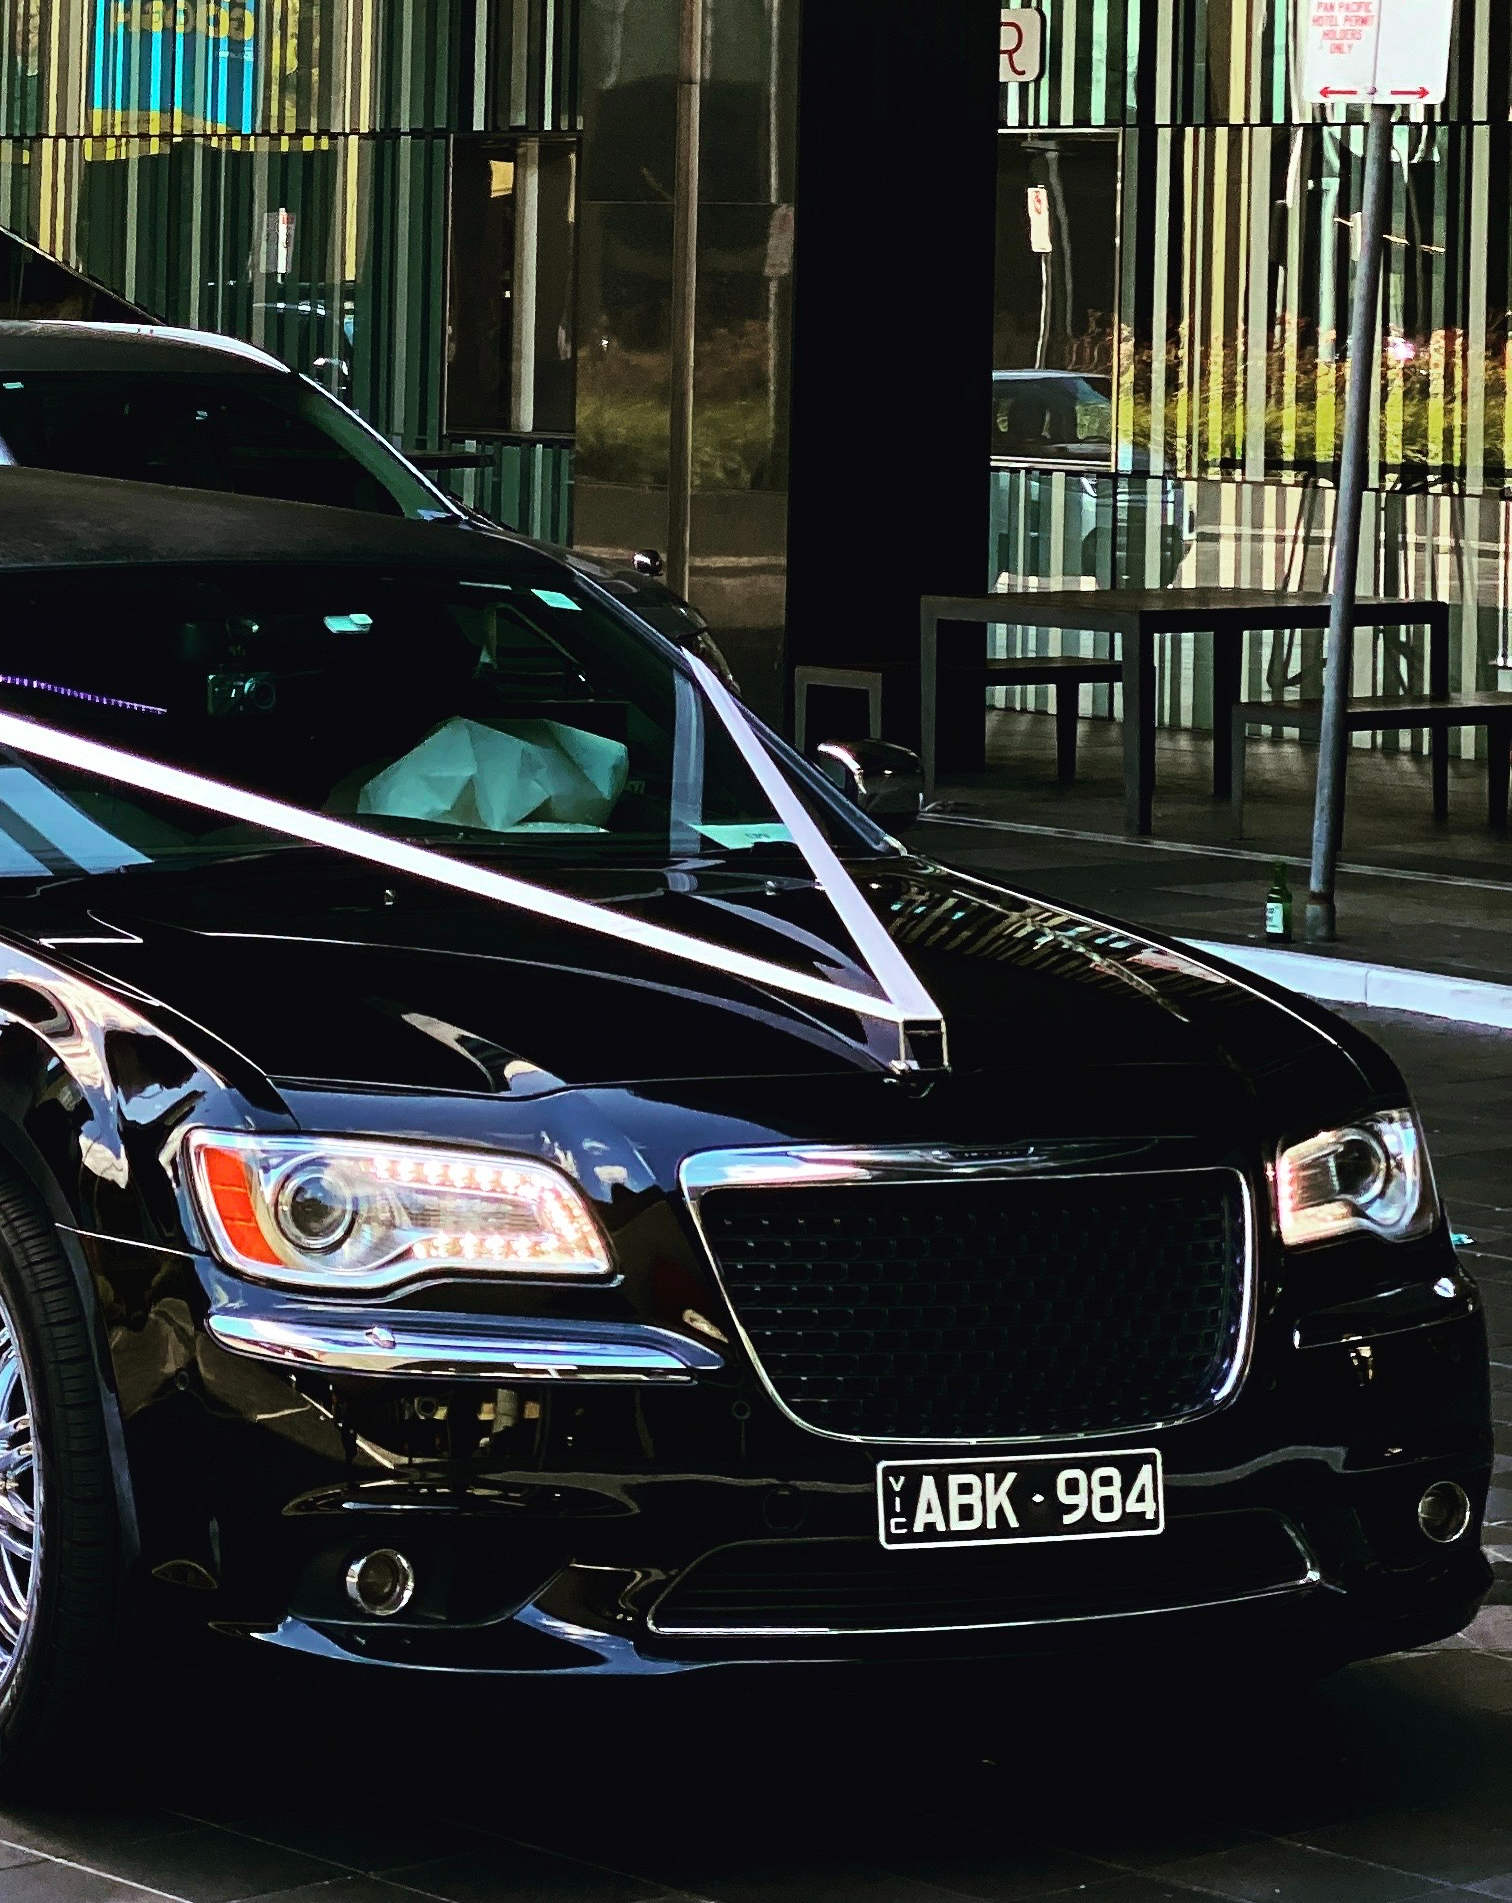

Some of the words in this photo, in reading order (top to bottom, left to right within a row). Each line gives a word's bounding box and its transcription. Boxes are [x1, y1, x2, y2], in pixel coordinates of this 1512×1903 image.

[1316, 2, 1335, 13] PAN
[1338, 2, 1373, 13] PACIFIC
[1312, 15, 1338, 27] HOTEL
[1344, 15, 1375, 27] PERMIT
[1323, 29, 1363, 40] HOLDERS
[1329, 43, 1353, 54] ONLY
[913, 1472, 1020, 1533] ABK
[1056, 1464, 1156, 1525] 984
[889, 1475, 908, 1534] VIC
